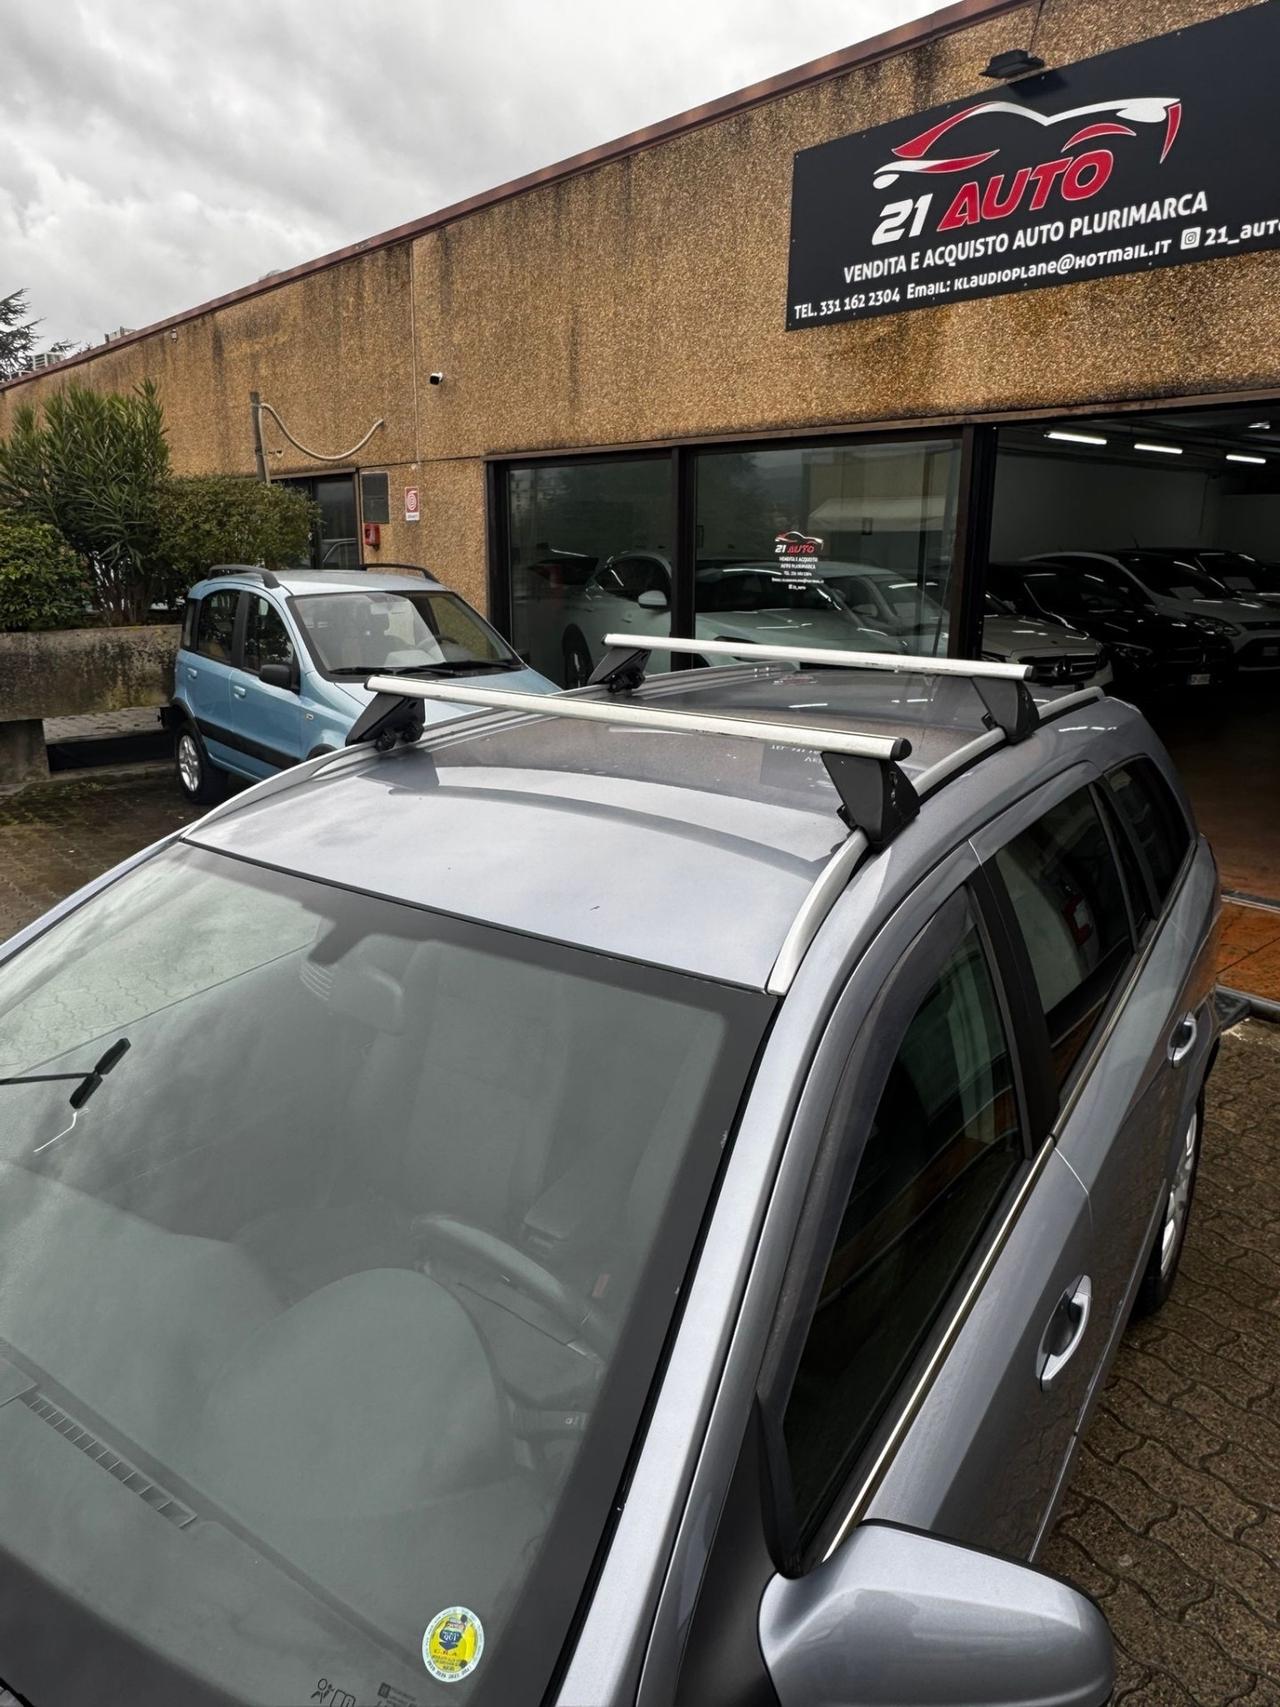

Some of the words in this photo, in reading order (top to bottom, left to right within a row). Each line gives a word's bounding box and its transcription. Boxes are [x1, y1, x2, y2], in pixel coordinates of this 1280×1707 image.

[871, 193, 934, 245] 21
[936, 149, 1114, 232] AUTO
[843, 254, 907, 284] VENDITA
[910, 251, 921, 270] E
[922, 233, 1009, 268] ACQUISTO
[1012, 221, 1064, 250] AUTO
[1069, 190, 1208, 239] PLURIMARCA
[794, 303, 818, 319] TEL.
[819, 299, 841, 316] 331
[844, 294, 866, 311] 162
[868, 287, 901, 306] 2304
[775, 544, 787, 553] 21
[787, 544, 815, 553] AUTO
